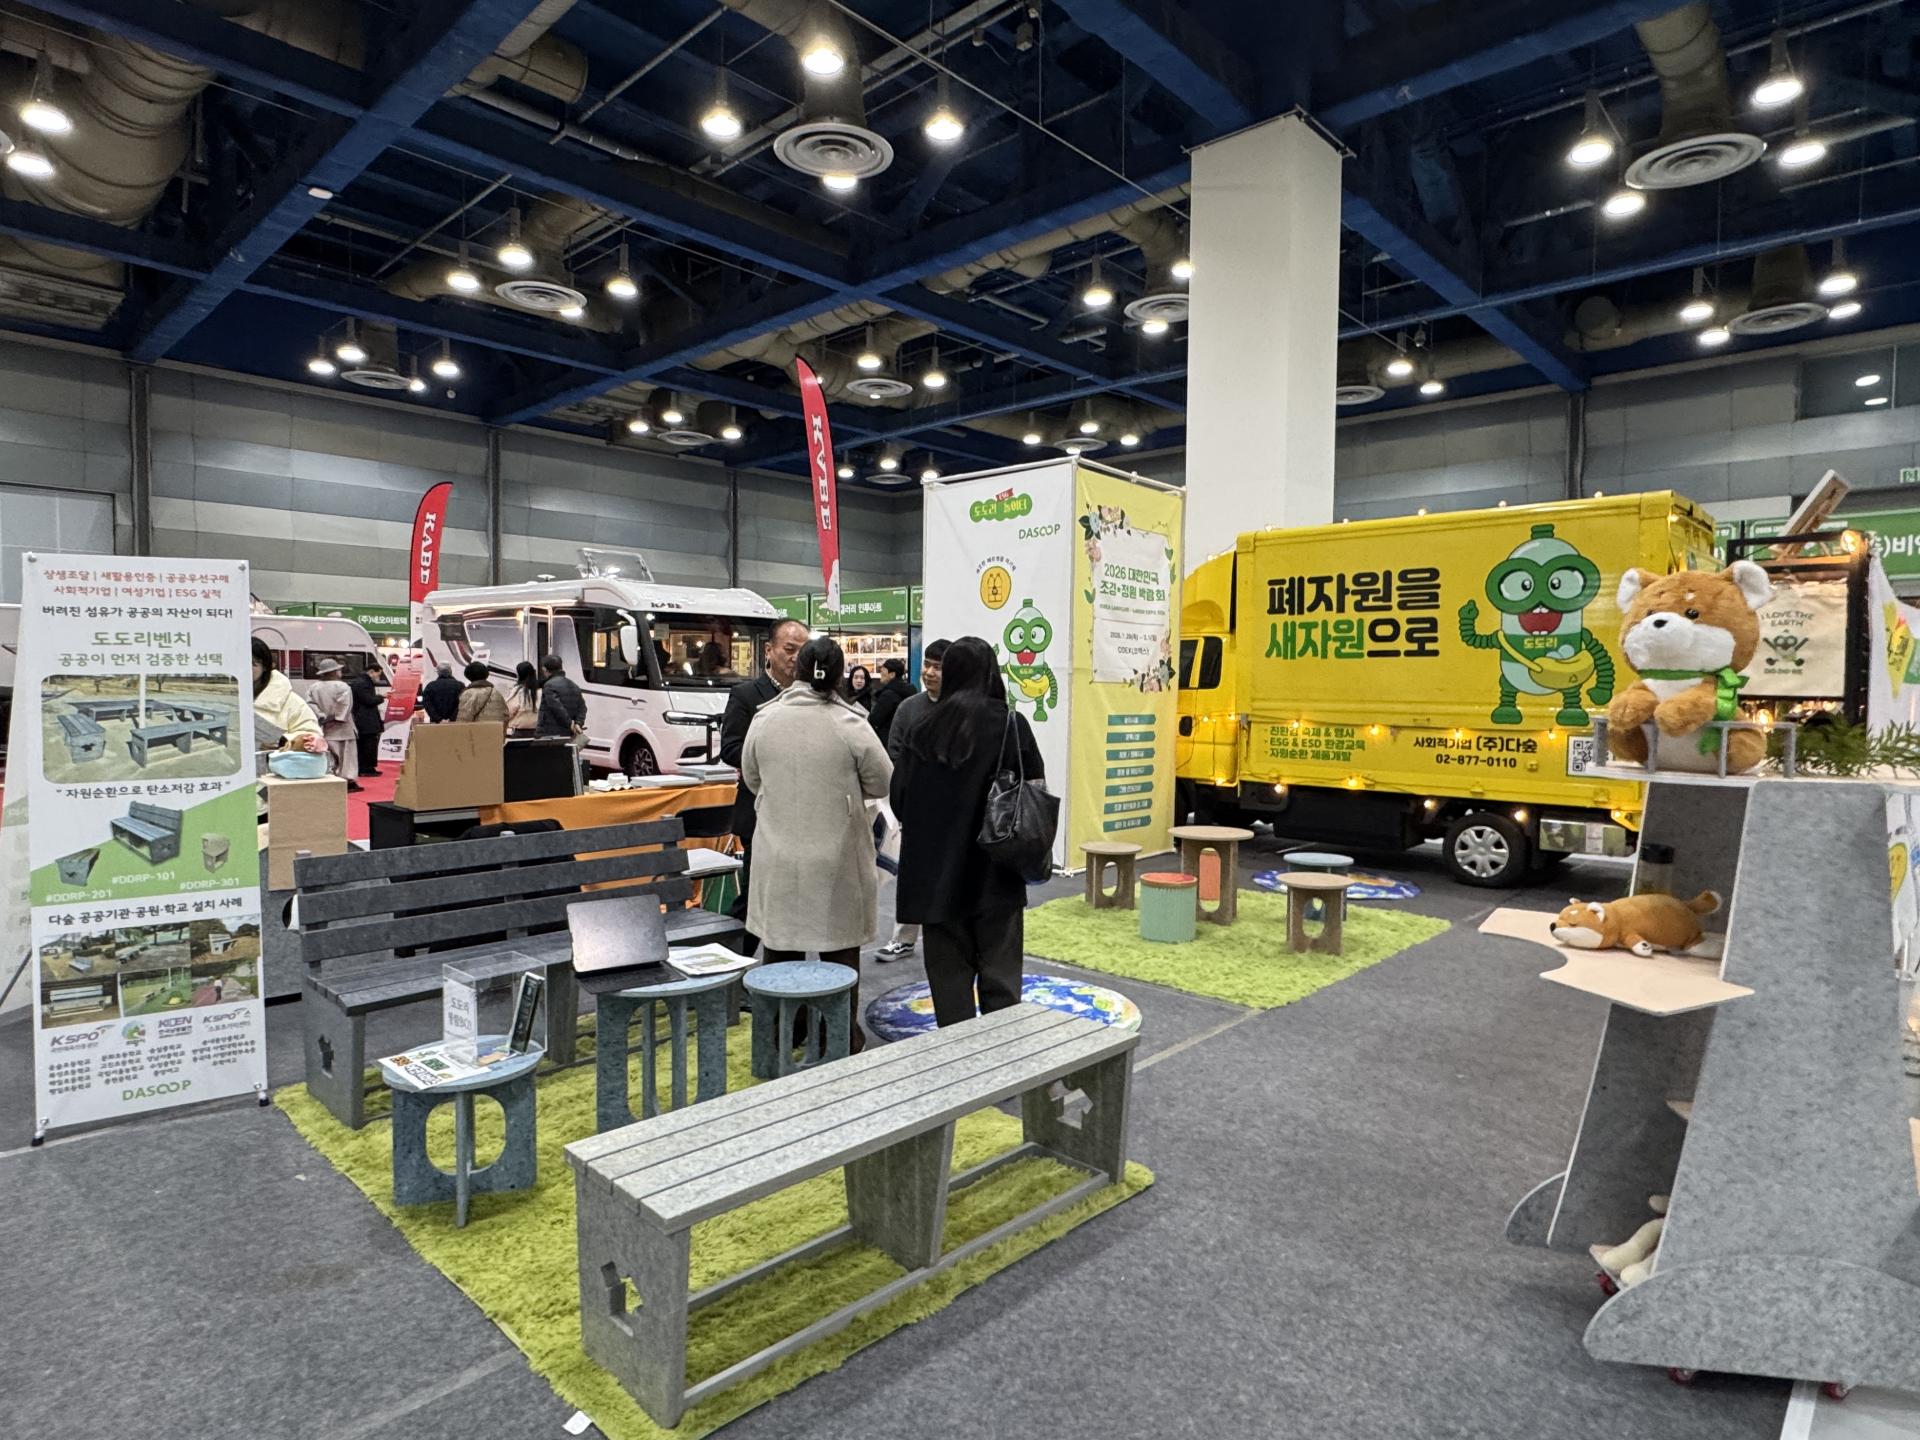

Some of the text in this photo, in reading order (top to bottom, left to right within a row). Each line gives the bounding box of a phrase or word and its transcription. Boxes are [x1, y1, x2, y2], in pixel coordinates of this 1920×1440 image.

[811, 414, 832, 530] KABE
[420, 511, 437, 585] KABE
[43, 569, 90, 581] 상생조달
[166, 573, 230, 584] 공공우선구매
[1104, 562, 1160, 586] 2026 대한민국
[121, 587, 166, 598] 여성기업
[175, 588, 197, 598] ESG
[1138, 587, 1166, 602] 박람회
[1266, 566, 1441, 616] 폐자원을
[42, 605, 232, 619] 버려진 섬유가 공공의 자산이 되다!
[1766, 610, 1792, 619] LOVE
[91, 631, 192, 649] 도도리벤치
[1264, 616, 1440, 661] 새자원으로
[1523, 636, 1558, 649] 도도리
[58, 653, 223, 667] 공공이 먼저 검증한 선택
[1269, 737, 1289, 747] ESG
[1301, 738, 1322, 749] ESD
[1413, 735, 1538, 754] 사회적기업 (주)다숲
[1435, 753, 1517, 768] 02-877-0110
[66, 780, 222, 800] 자원순환으로 탄소저감 효과
[48, 914, 76, 926] 다숲
[192, 899, 217, 914] 설치
[219, 896, 243, 909] 사례
[50, 1031, 100, 1047] KSPO
